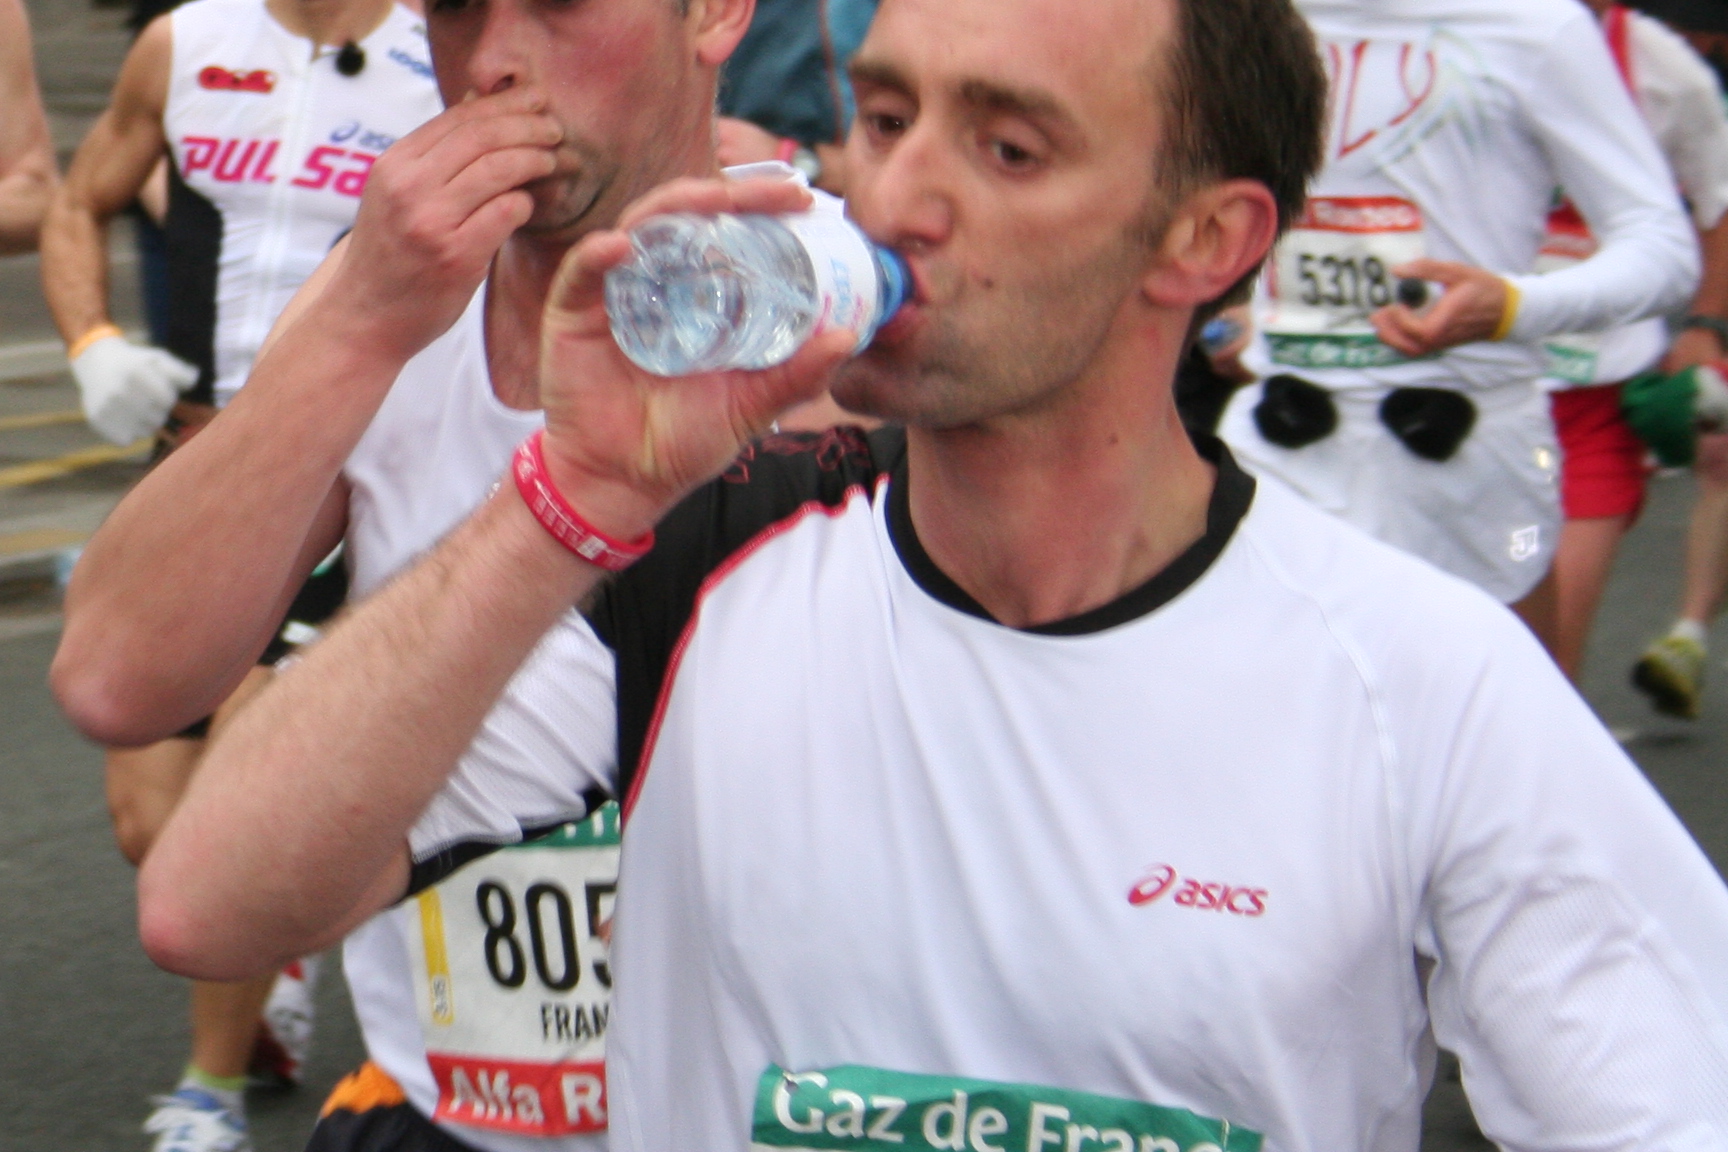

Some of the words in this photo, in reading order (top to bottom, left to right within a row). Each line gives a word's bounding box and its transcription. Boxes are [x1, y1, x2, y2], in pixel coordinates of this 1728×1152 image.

[1299, 253, 1391, 307] 5318
[1173, 878, 1269, 917] asics
[475, 880, 619, 992] 805
[541, 1000, 610, 1042] FRAN
[447, 1064, 545, 1126] Alfa
[774, 1071, 907, 1144] Gaz
[921, 1089, 1009, 1152] de
[1026, 1100, 1224, 1152] Fra
